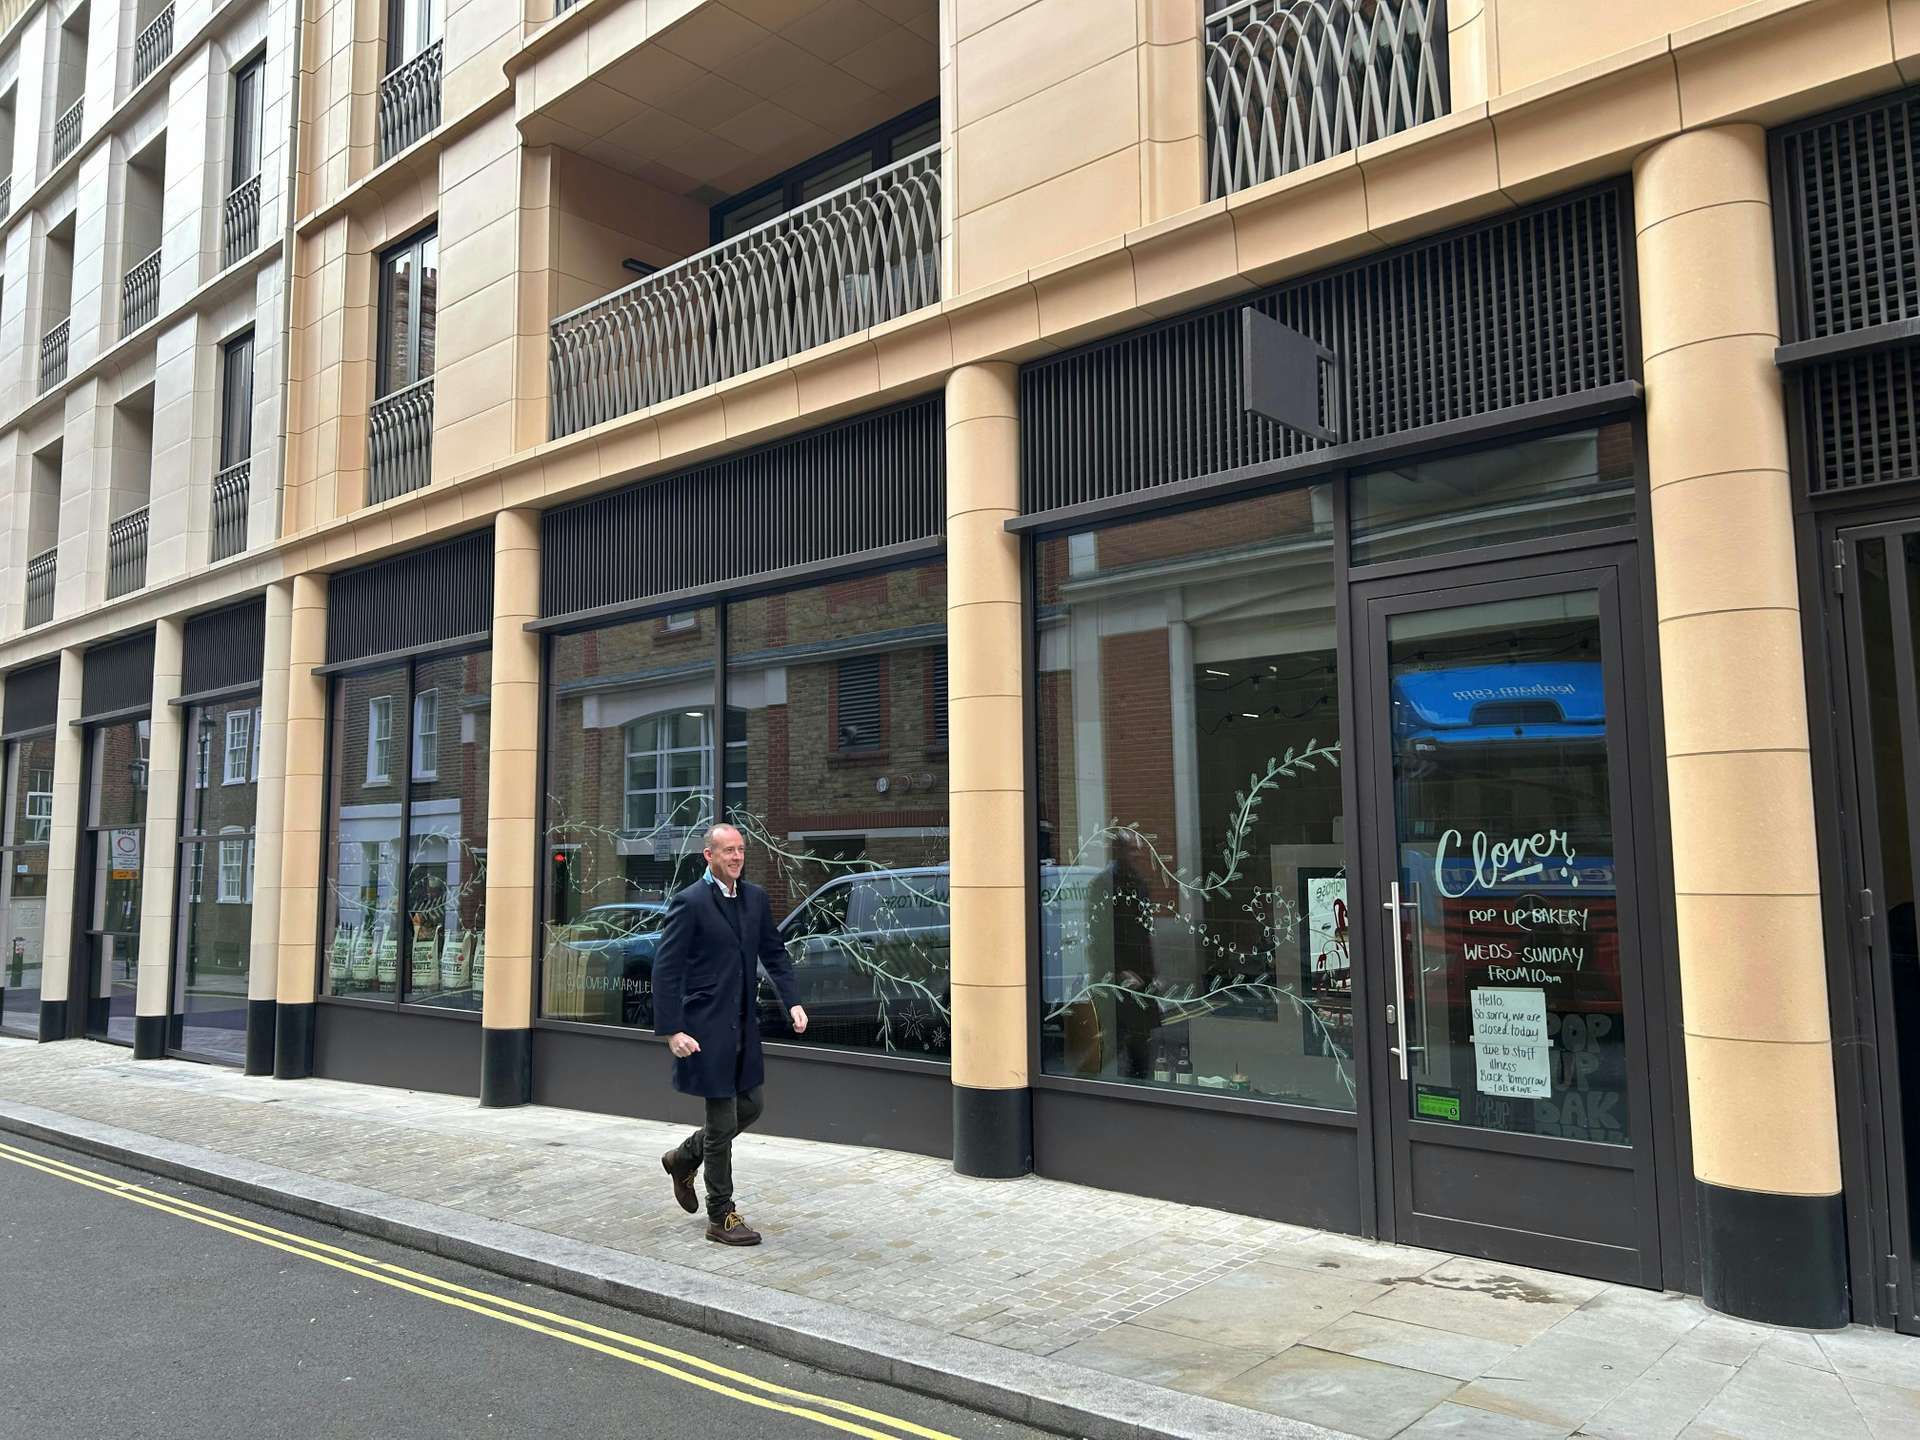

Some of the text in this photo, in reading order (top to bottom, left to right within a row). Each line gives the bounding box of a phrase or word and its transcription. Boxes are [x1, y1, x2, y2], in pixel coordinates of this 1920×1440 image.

[1434, 829, 1576, 898] Clover
[1469, 908, 1588, 931] POP UP BAKERY
[1474, 1008, 1484, 1019] So
[1512, 1012, 1524, 1020] we
[1526, 1013, 1541, 1022] are
[1511, 1024, 1539, 1042] today
[1482, 1044, 1499, 1055] due
[1502, 1044, 1510, 1056] to
[1489, 1058, 1517, 1072] illness
[1480, 1069, 1547, 1087] Back tomorrow
